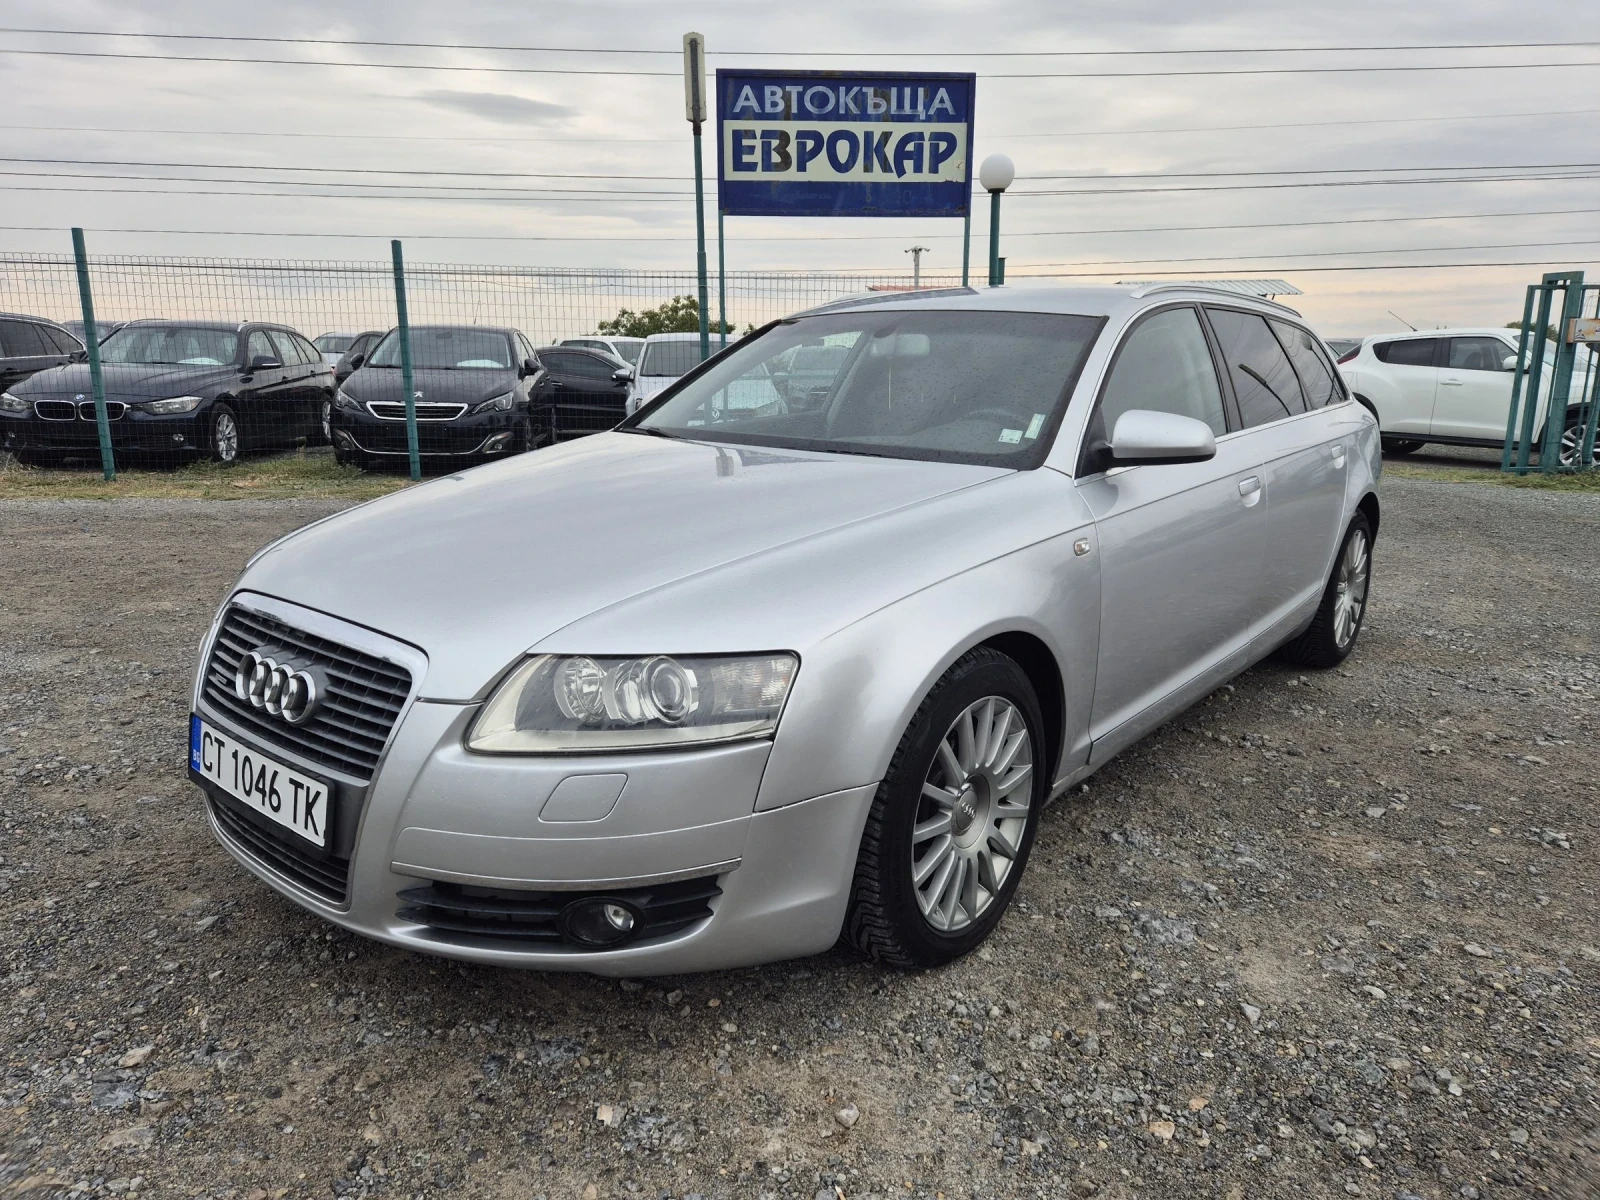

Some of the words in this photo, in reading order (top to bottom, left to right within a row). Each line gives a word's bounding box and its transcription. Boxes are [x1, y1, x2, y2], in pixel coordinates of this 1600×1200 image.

[732, 84, 957, 120] АВТОКЪЩА
[731, 129, 958, 178] ЕВРОКАР
[203, 731, 225, 779] CT
[232, 749, 282, 813] 1046
[289, 777, 322, 837] TK
